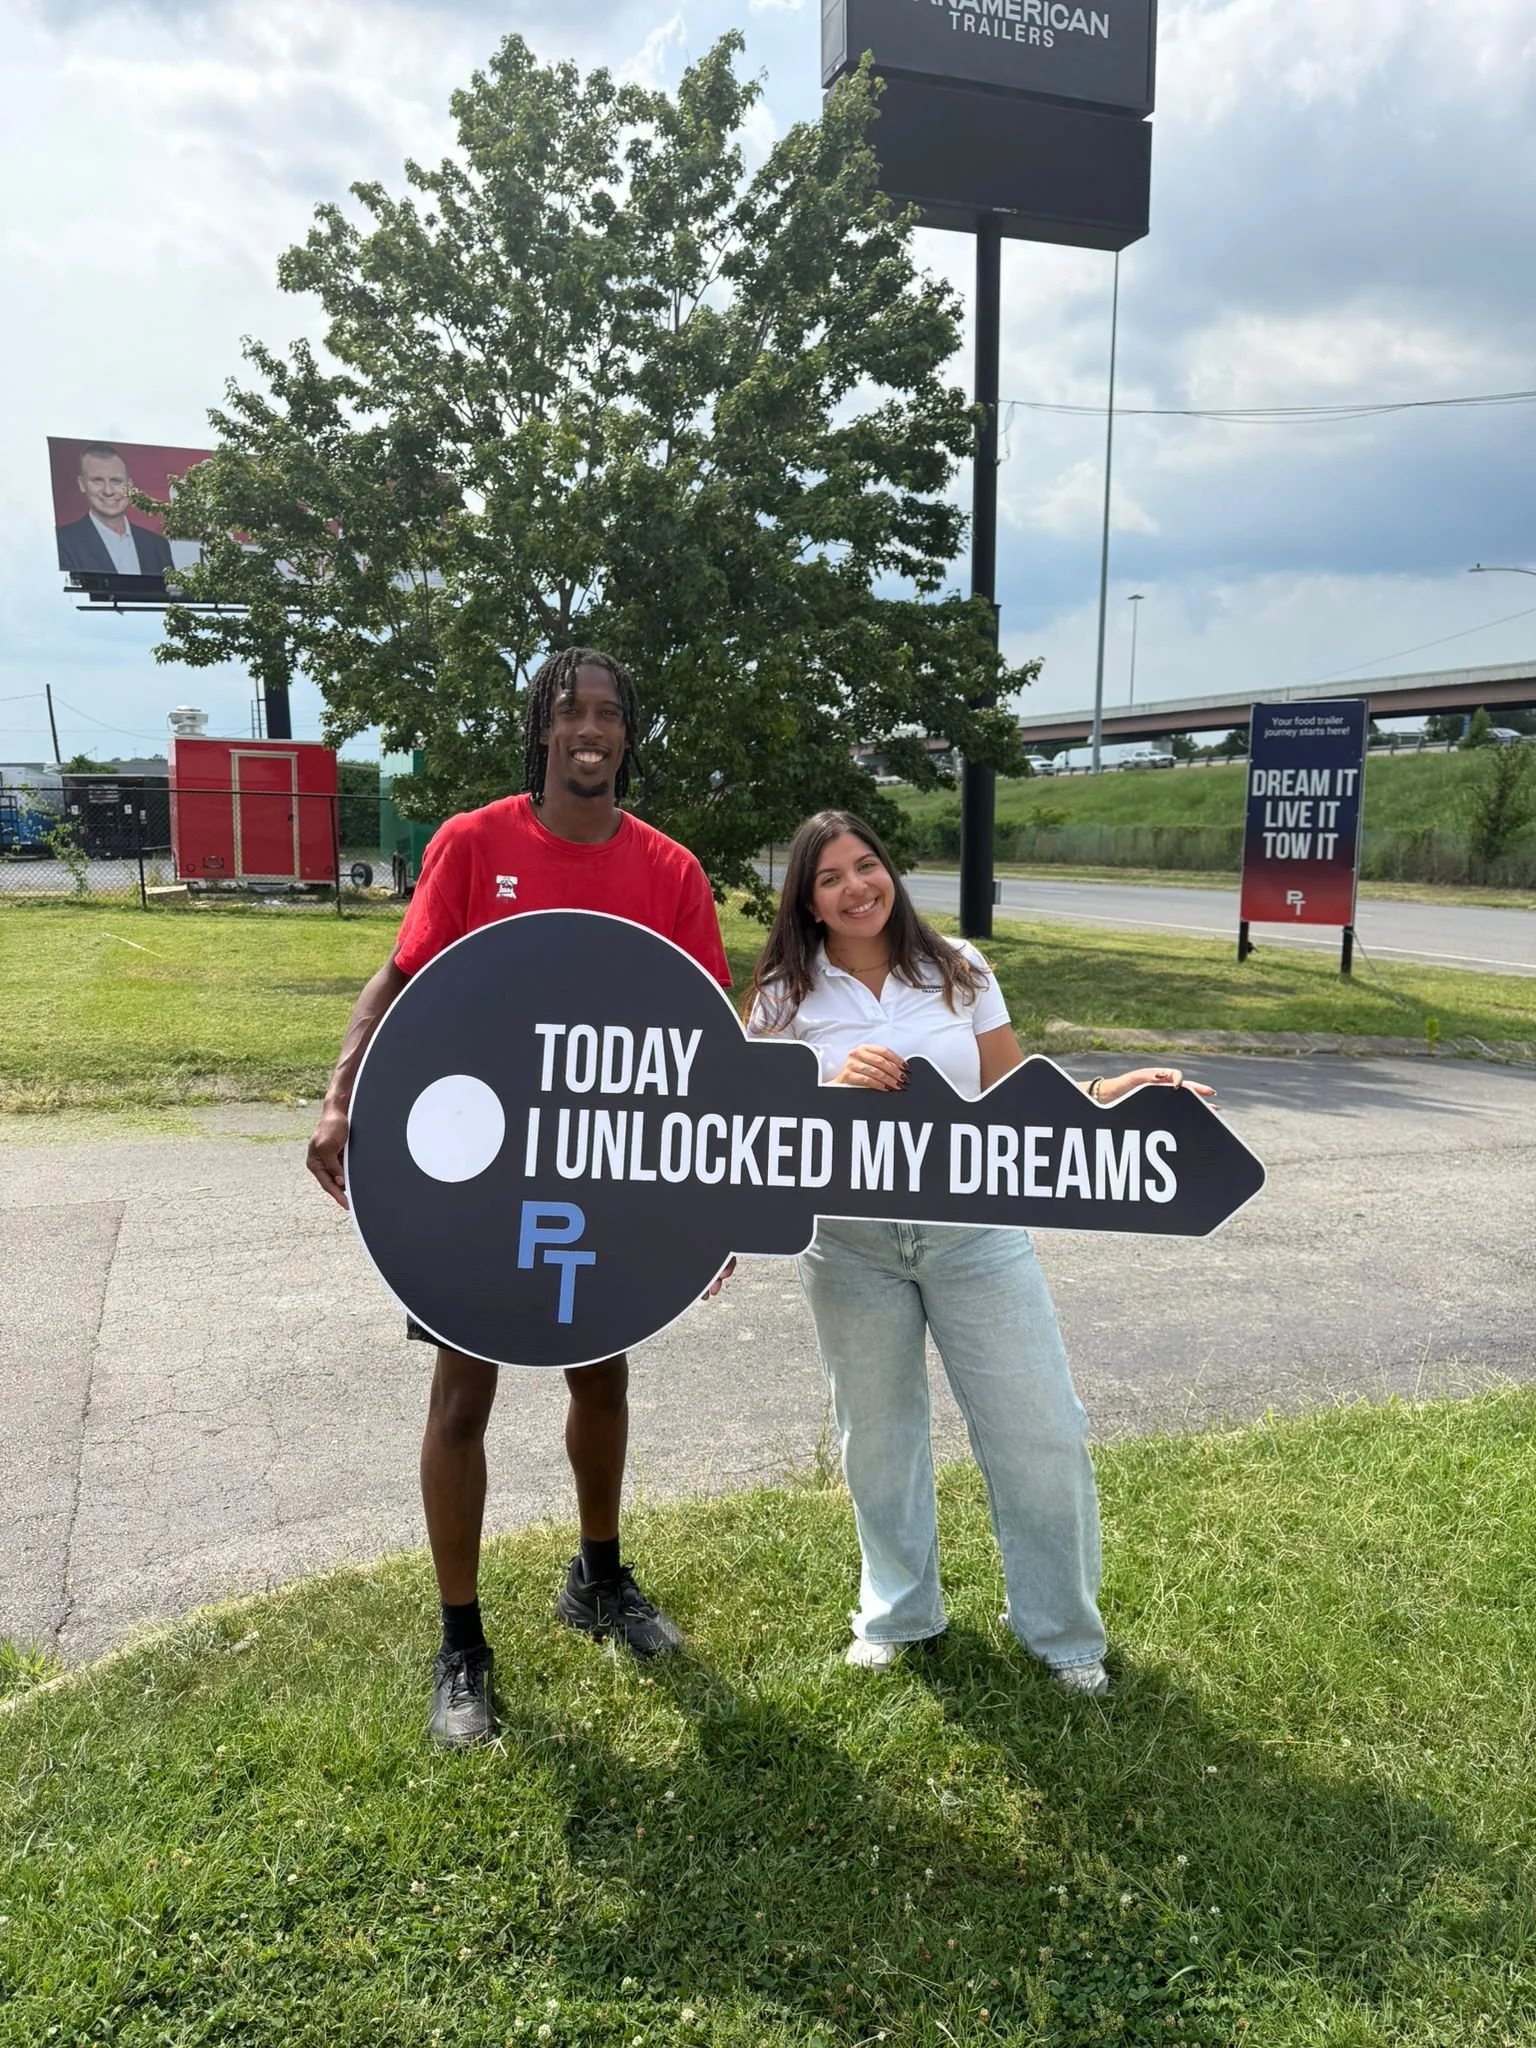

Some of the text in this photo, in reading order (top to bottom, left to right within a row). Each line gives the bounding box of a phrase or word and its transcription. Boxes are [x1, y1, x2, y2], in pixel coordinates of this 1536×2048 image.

[912, 0, 1109, 39] AMERICAN
[949, 11, 1054, 48] TRAILERS
[1264, 726, 1350, 739] journey starts here!
[1272, 715, 1344, 726] Your food trailer
[1252, 769, 1358, 797] DREAM IT
[1264, 801, 1340, 828] LIVE IT
[1262, 832, 1339, 860] TOW IT
[535, 1024, 703, 1096] TODAY
[524, 1107, 1178, 1204] I UNLOCKED MY DREAMS
